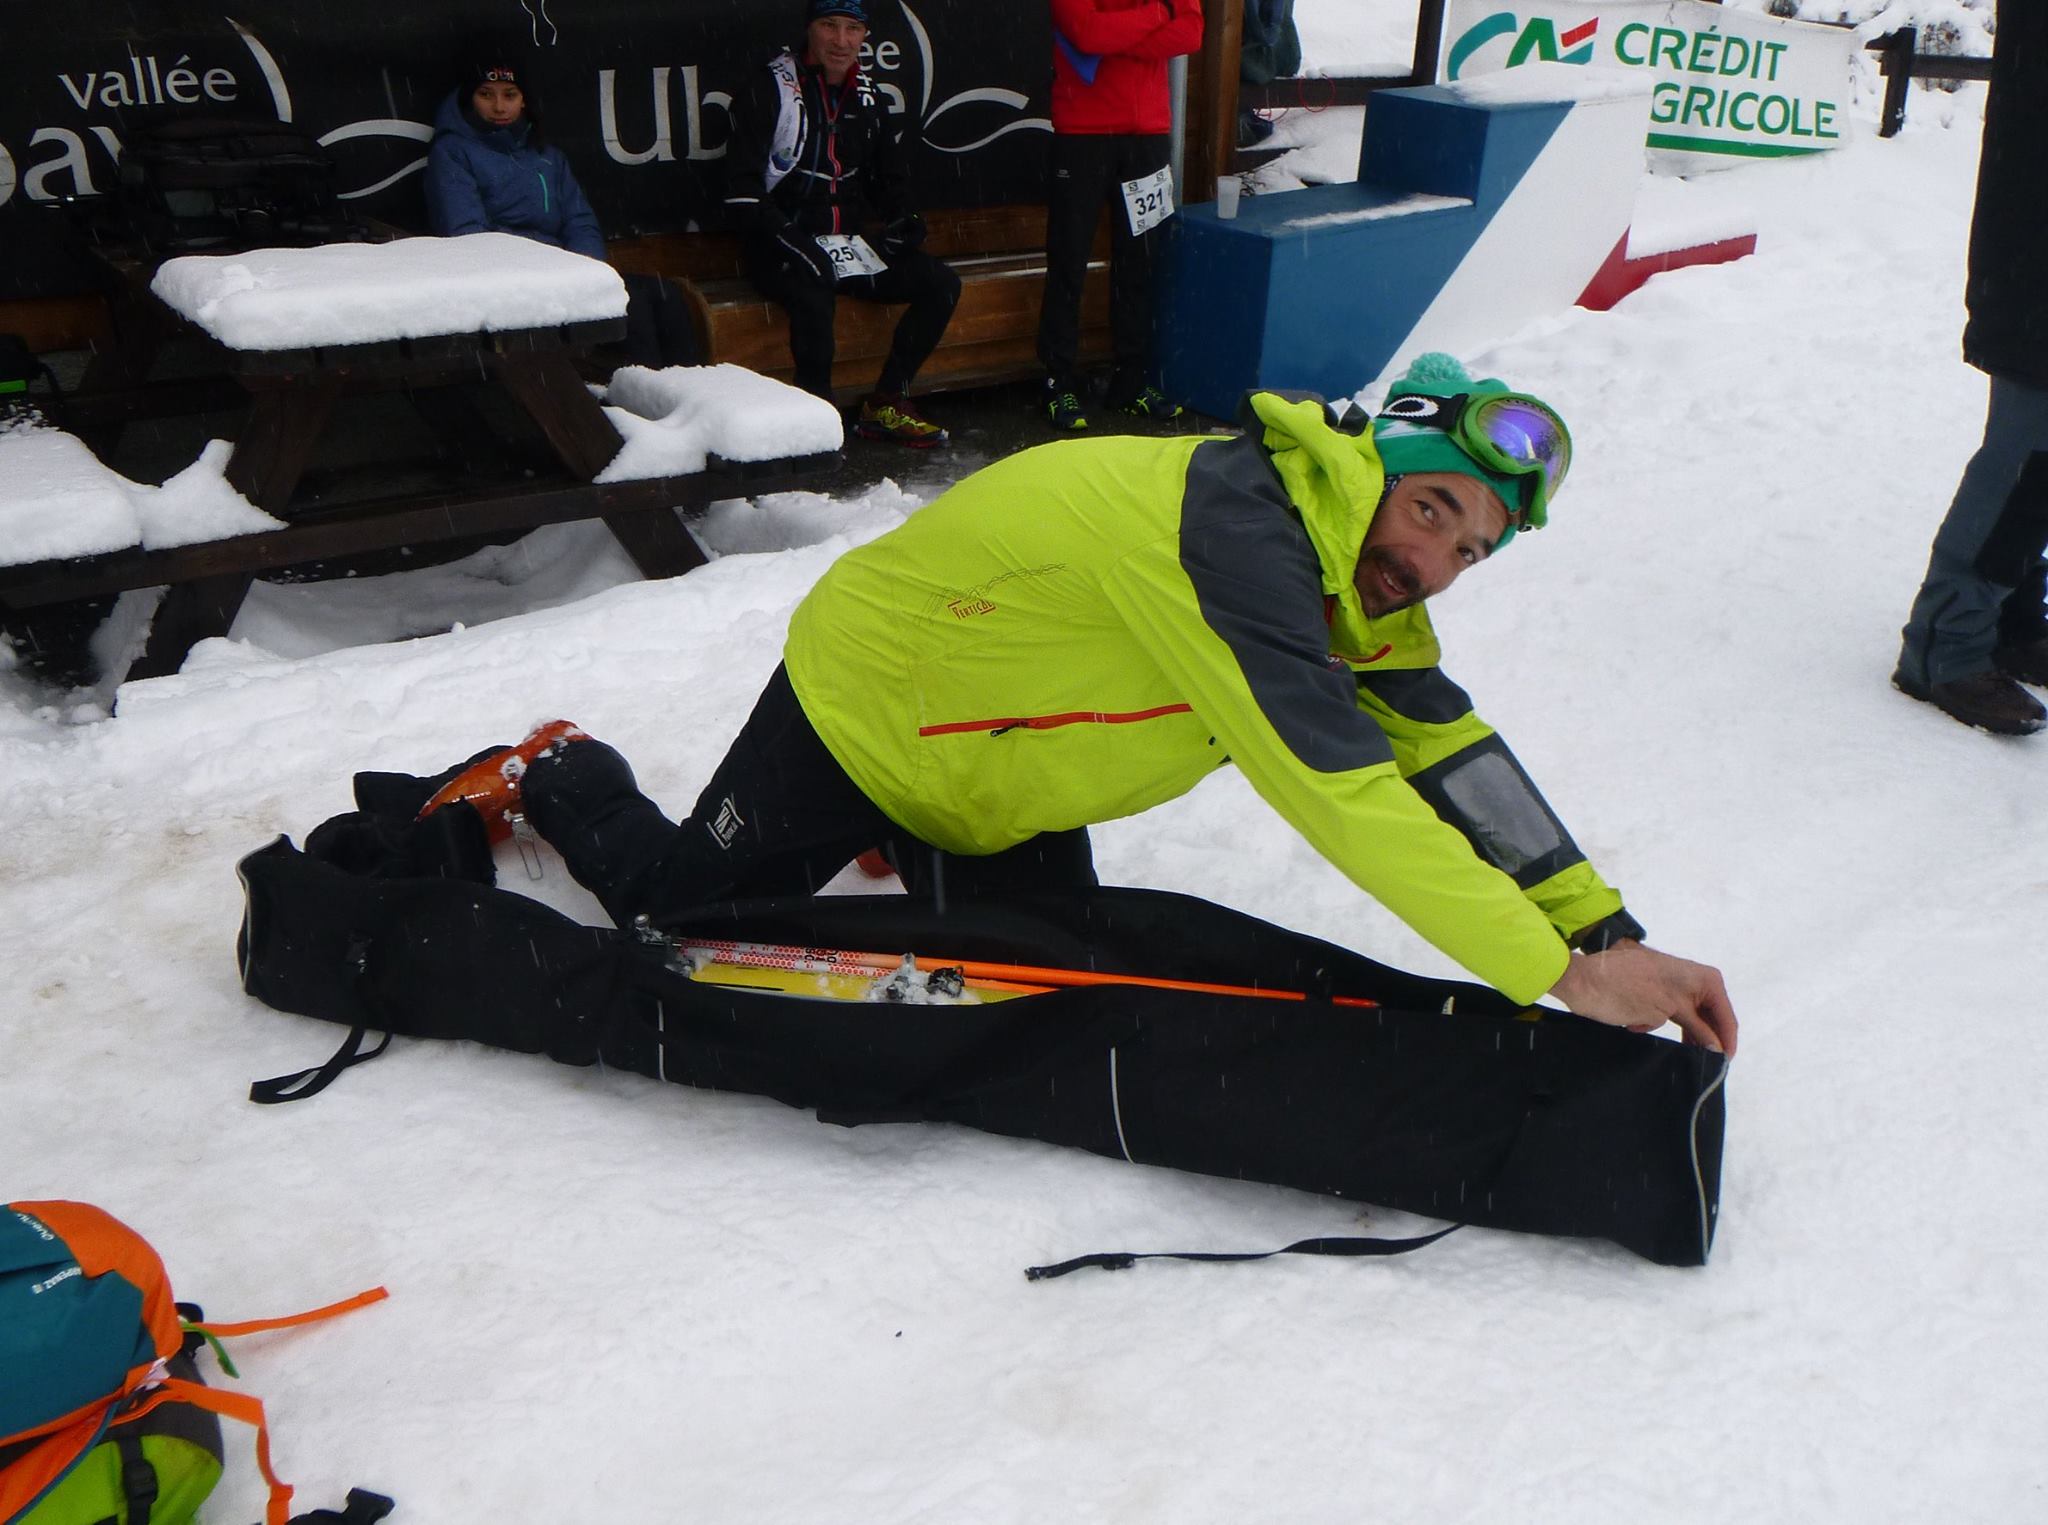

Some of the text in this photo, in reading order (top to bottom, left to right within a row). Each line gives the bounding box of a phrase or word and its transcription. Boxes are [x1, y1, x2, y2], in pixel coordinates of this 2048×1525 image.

[1615, 22, 1789, 82] CRÉDIT
[57, 53, 237, 111] vallée
[1650, 82, 1839, 139] GRICOLE
[1135, 187, 1163, 216] 321
